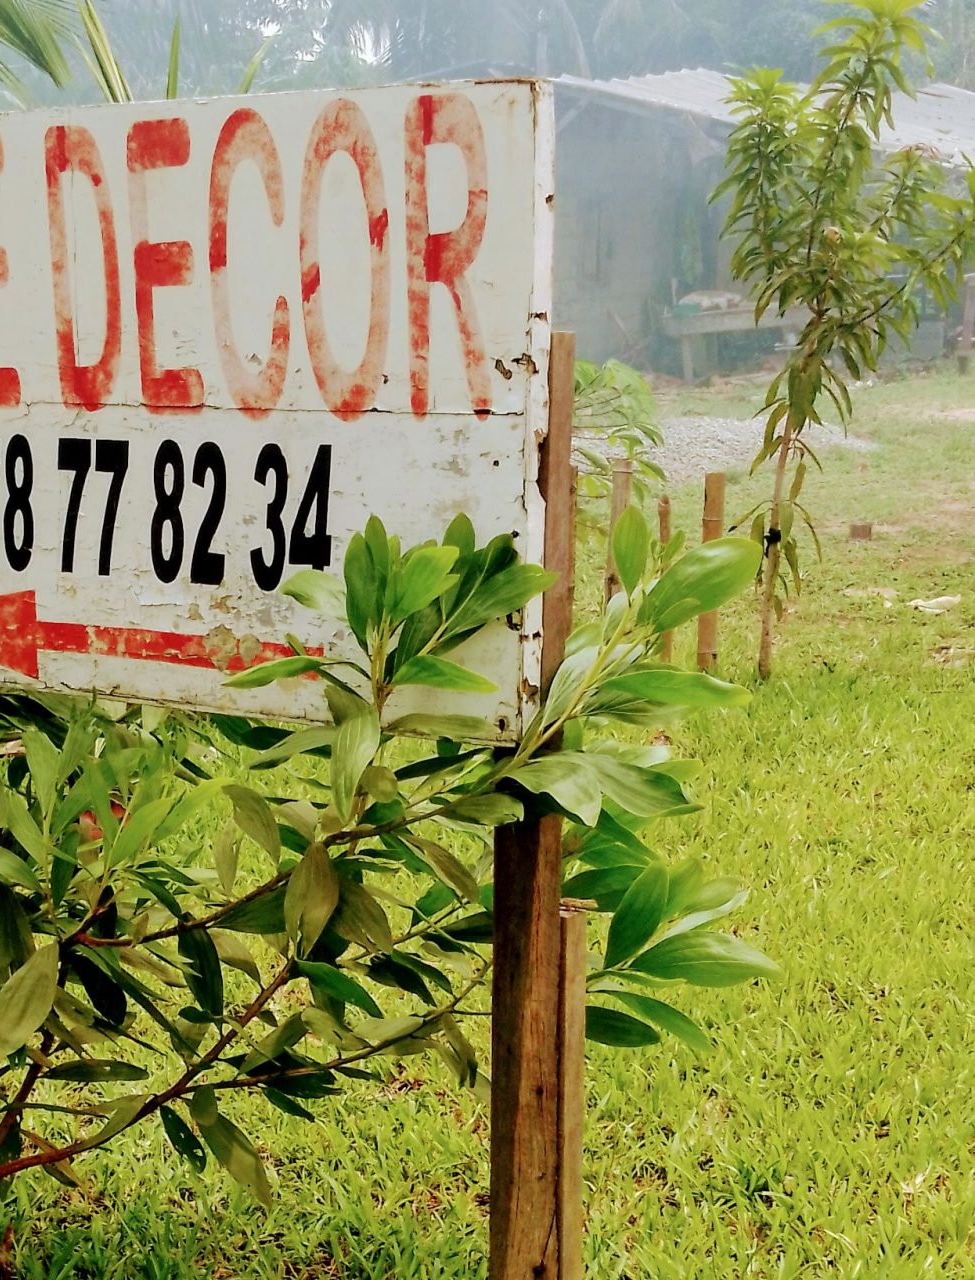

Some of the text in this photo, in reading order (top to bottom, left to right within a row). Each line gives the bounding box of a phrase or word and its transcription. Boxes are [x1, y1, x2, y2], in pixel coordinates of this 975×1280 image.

[44, 95, 492, 421] DECOR
[58, 438, 130, 576] 77
[151, 439, 227, 585] 82
[250, 443, 332, 592] 34
